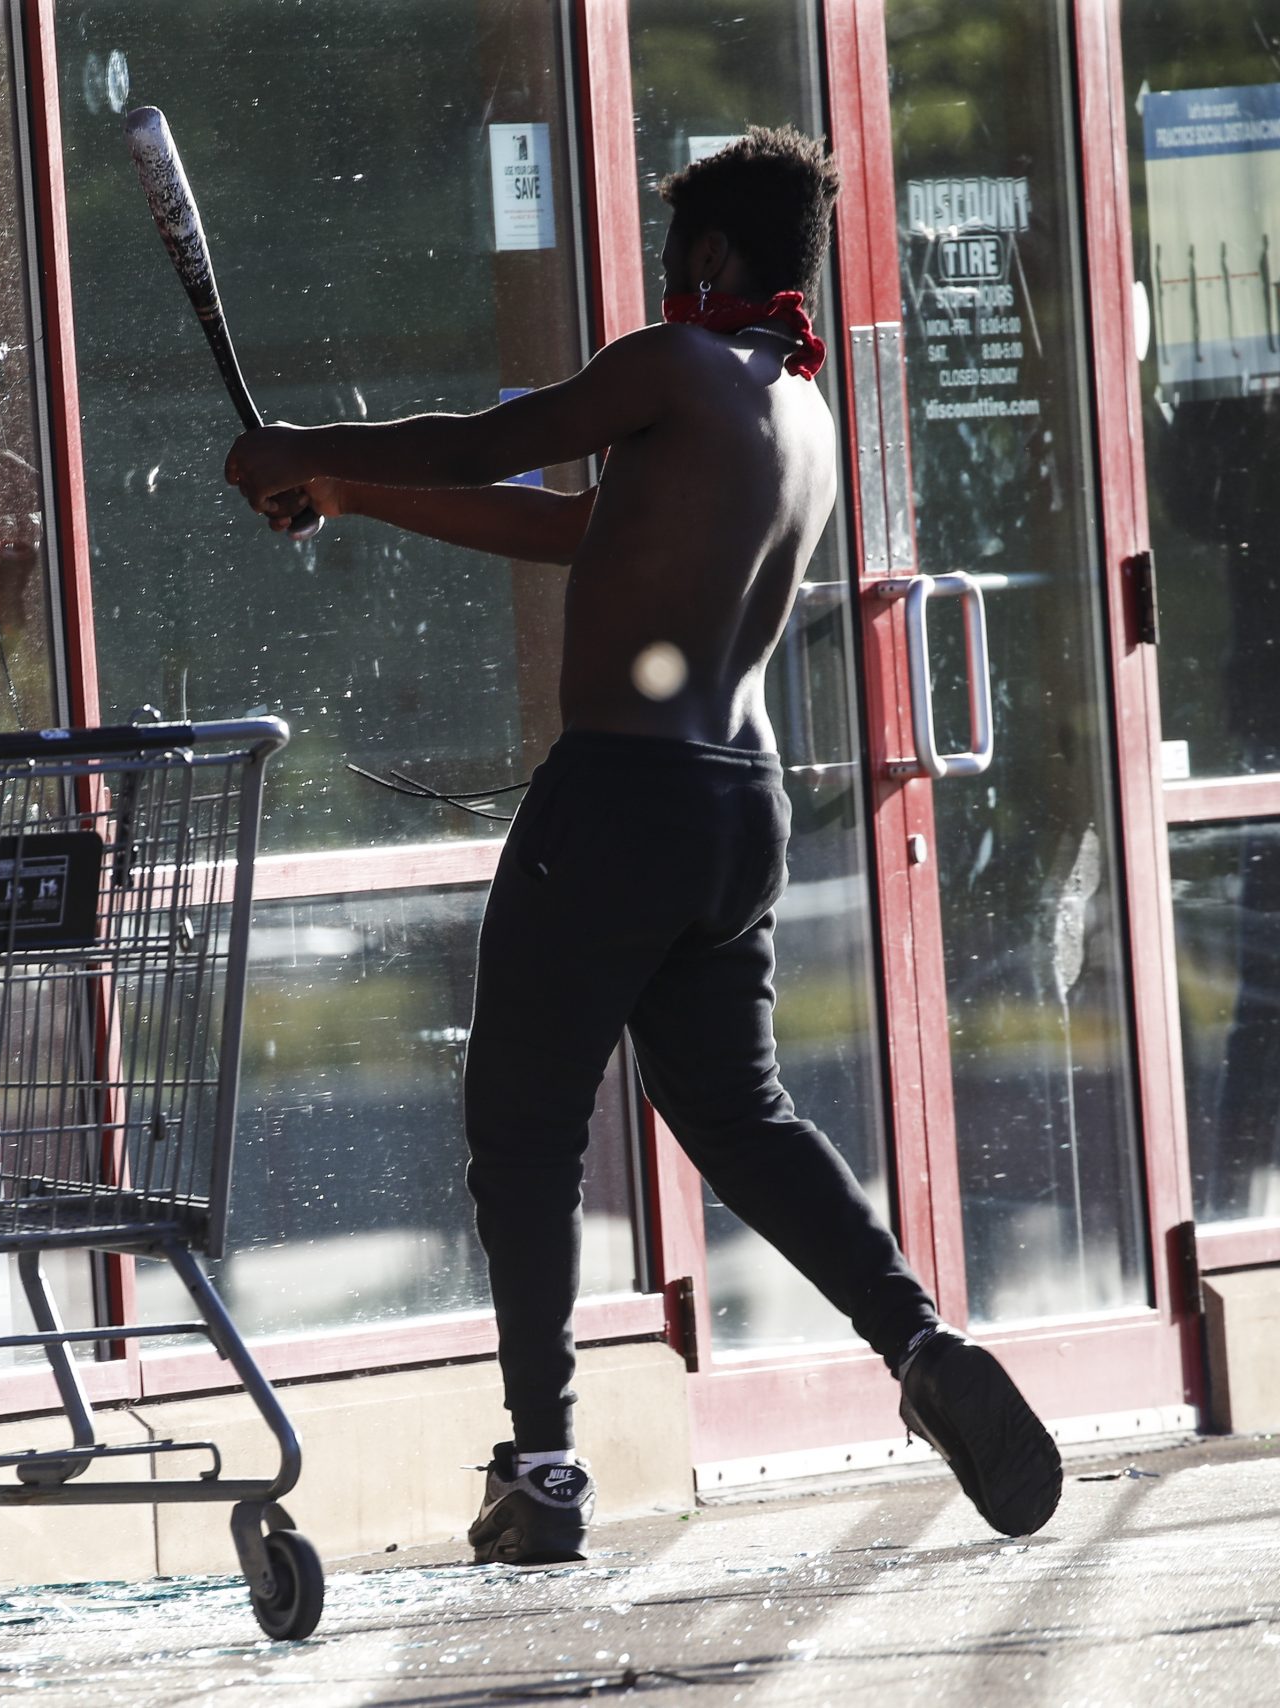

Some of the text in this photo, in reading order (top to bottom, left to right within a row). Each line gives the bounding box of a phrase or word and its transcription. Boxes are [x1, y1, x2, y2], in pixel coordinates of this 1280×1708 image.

[515, 177, 541, 199] SAVE
[907, 176, 1030, 237] DISCOUNT
[942, 241, 999, 277] TIRE
[939, 366, 1019, 387] CLOSED SUNDAY
[925, 396, 1041, 419] discounttire.com
[550, 1469, 572, 1479] NIKE
[552, 1488, 572, 1496] AIR
